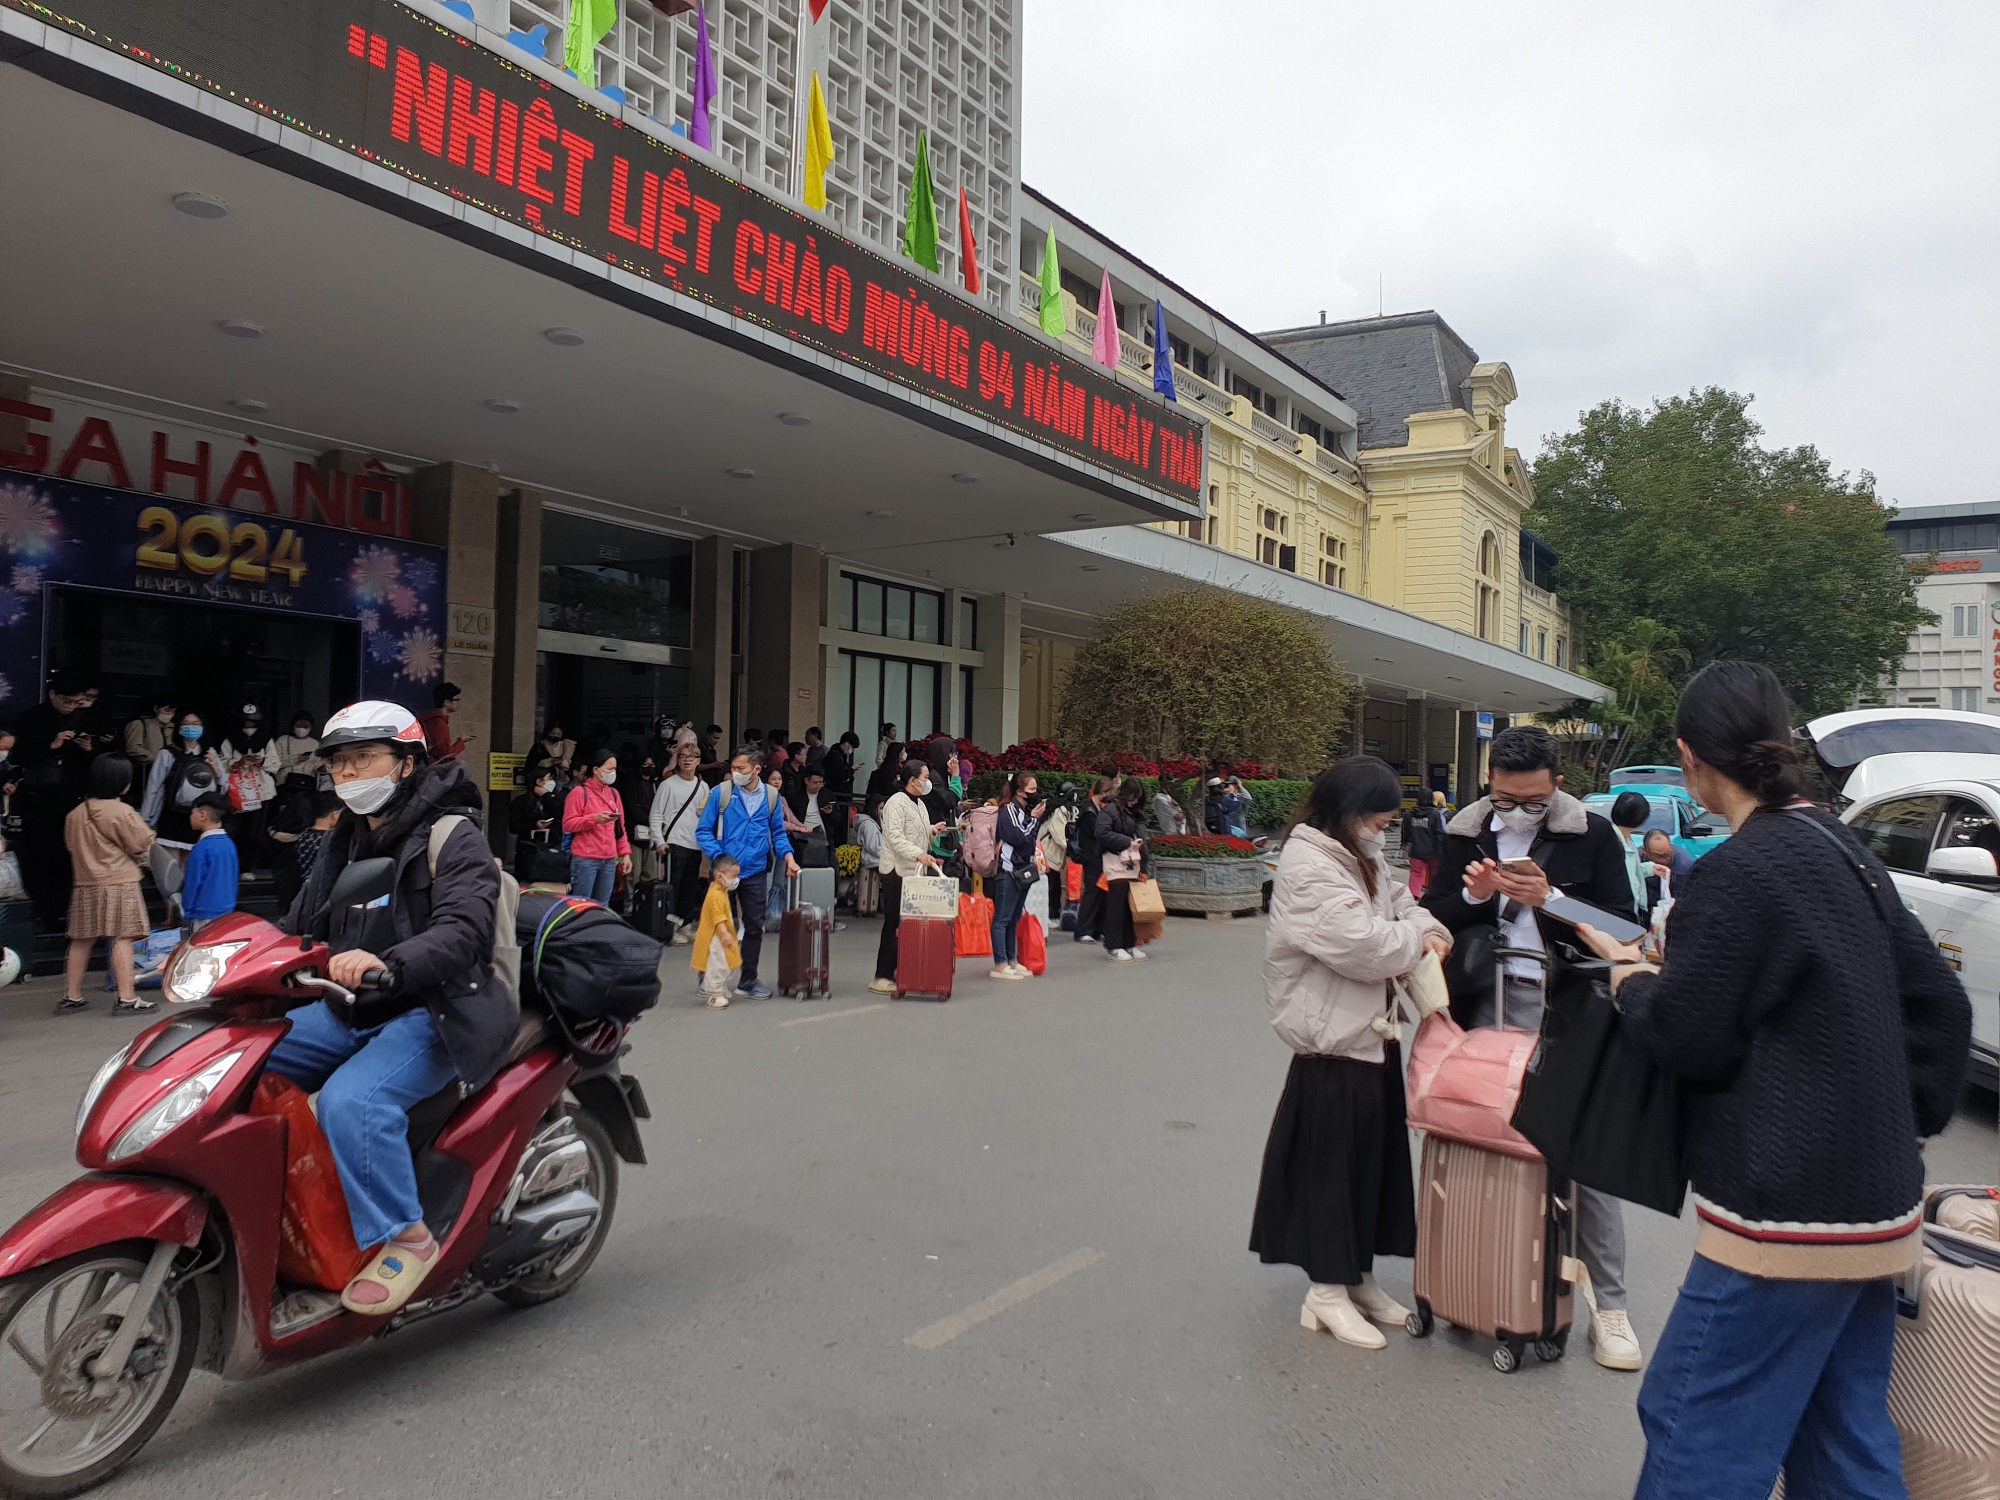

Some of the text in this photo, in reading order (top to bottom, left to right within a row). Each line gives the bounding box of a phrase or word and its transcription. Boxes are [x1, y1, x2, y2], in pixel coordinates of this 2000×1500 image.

[348, 23, 595, 223] "NHIỆT
[608, 155, 722, 278] LIỆT
[733, 219, 852, 335] CHÀO
[863, 281, 970, 389] MỪNG
[978, 340, 1015, 409] 94
[1023, 361, 1087, 441] NĂM
[1091, 394, 1154, 470] NGÀY
[0, 398, 134, 489] GA
[150, 430, 280, 515] HÀ
[136, 506, 307, 587] 2024
[135, 574, 294, 607] HAPPY NEW YEAR
[453, 610, 491, 636] 120
